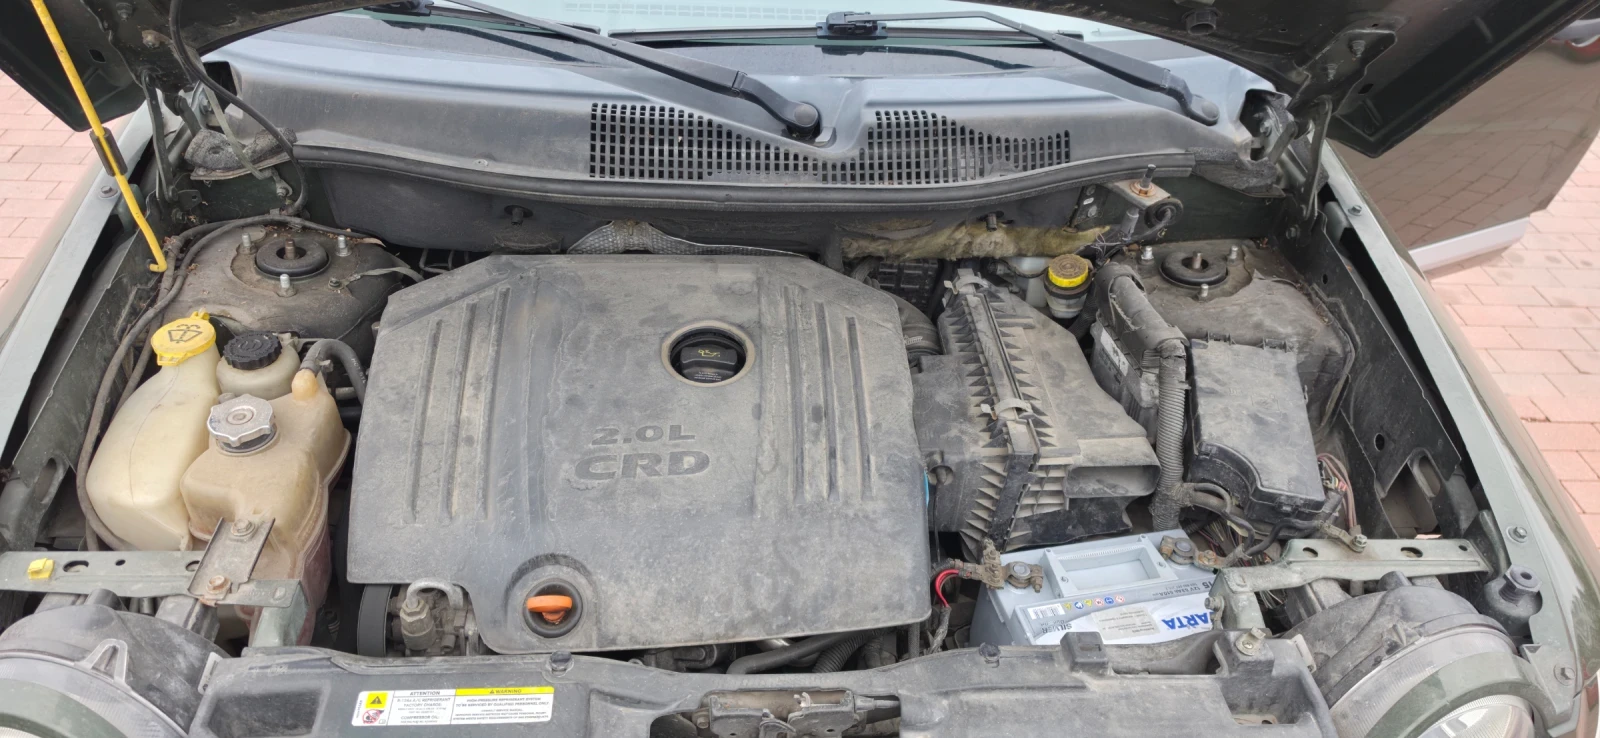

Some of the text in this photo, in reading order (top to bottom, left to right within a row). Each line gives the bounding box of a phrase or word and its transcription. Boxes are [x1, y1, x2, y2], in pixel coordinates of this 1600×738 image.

[591, 424, 696, 446] 2.0L
[575, 450, 710, 481] CRD
[1041, 623, 1072, 634] SILVER
[1161, 611, 1214, 630] ARTA
